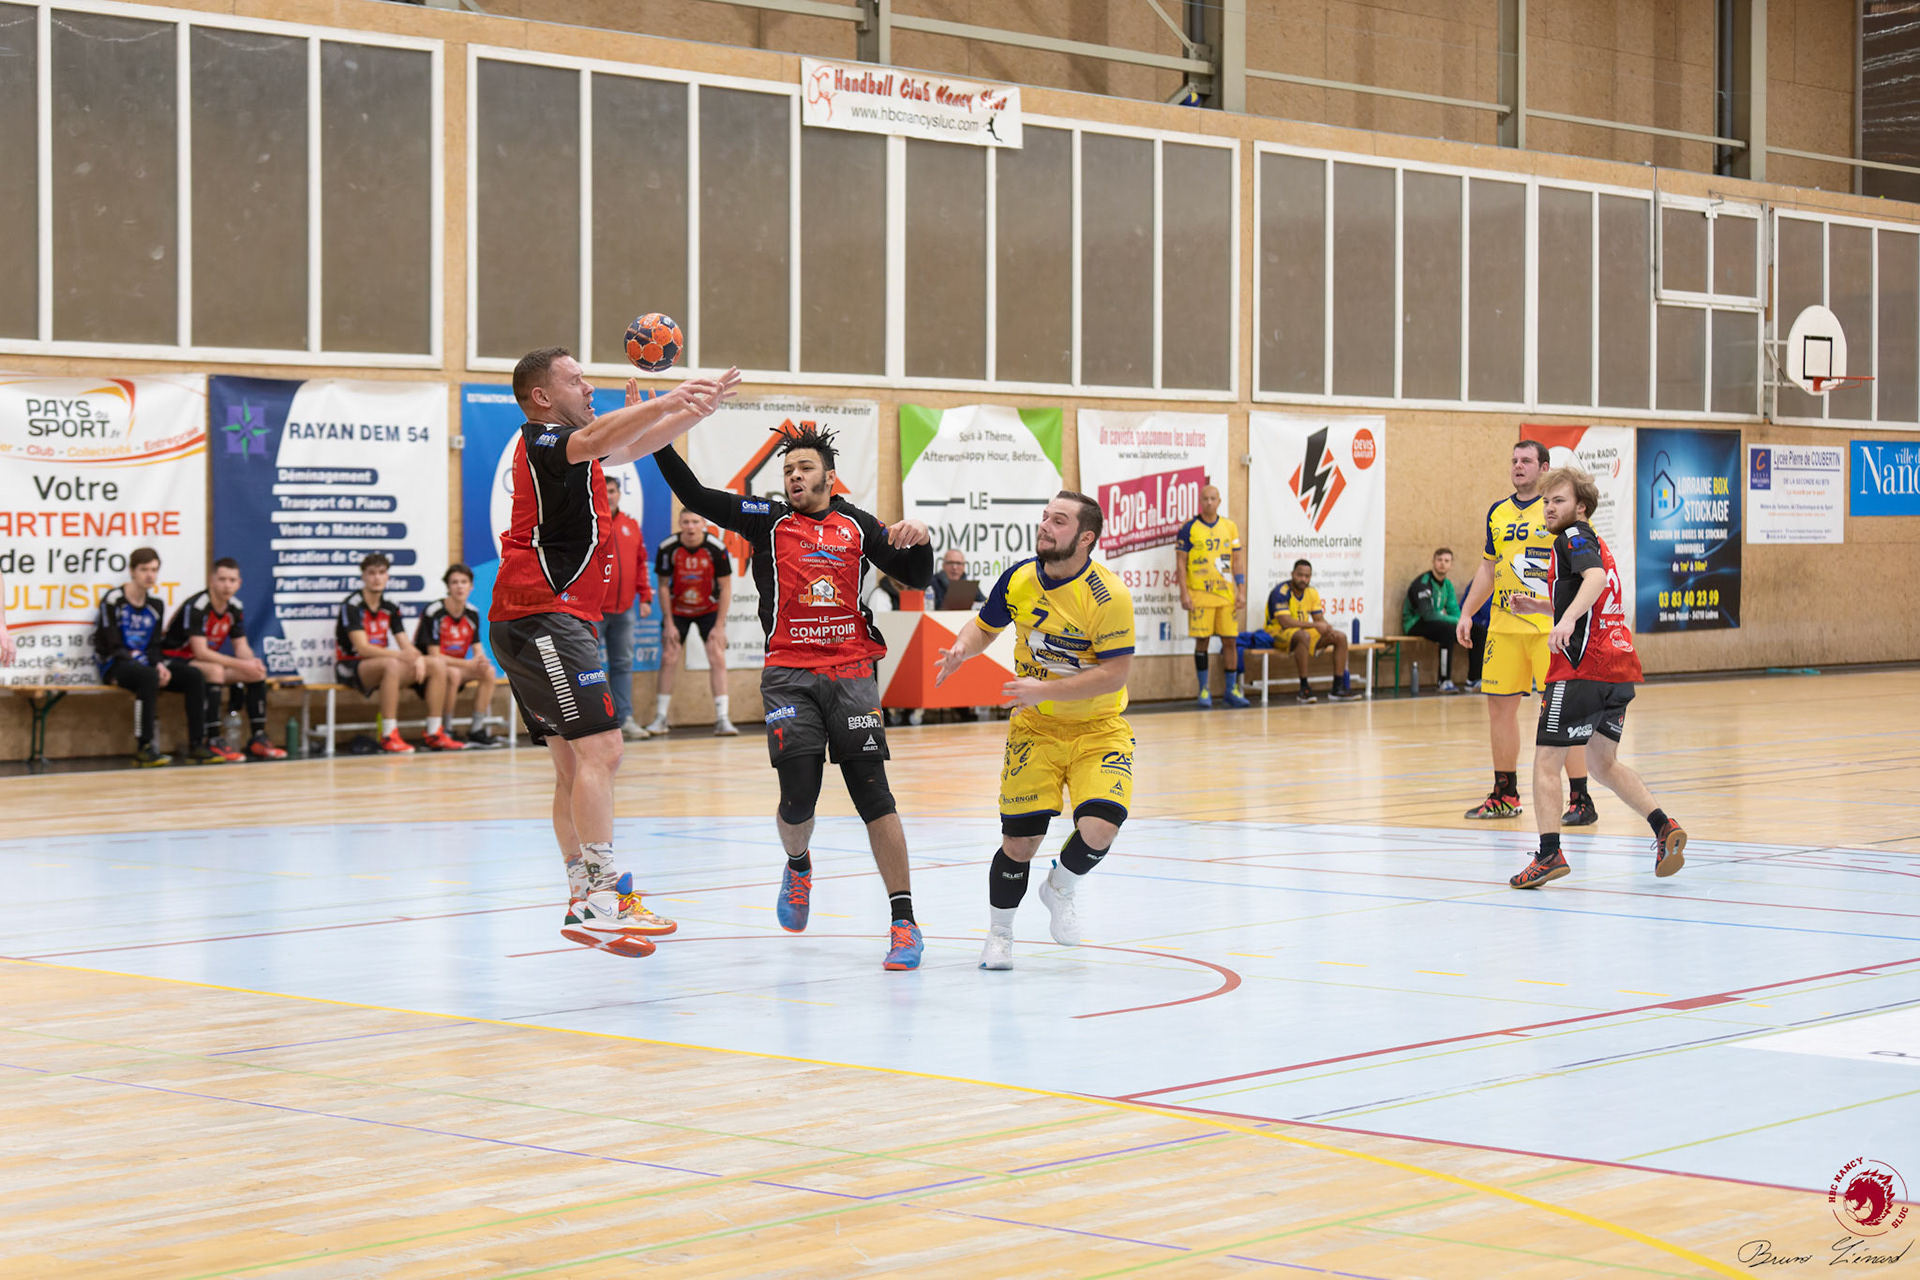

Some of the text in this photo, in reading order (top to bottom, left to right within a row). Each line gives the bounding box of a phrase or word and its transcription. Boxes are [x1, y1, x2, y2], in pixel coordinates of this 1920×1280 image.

[834, 69, 894, 97] Handball
[900, 78, 931, 102] Club
[935, 85, 975, 114] Nancy
[851, 105, 980, 132] www.hbcnancysluc.com
[26, 399, 92, 418] PAYS
[716, 401, 871, 416] truisons ensemble votre avenir
[289, 423, 429, 442] RAYAN DEM 54
[1597, 448, 1618, 459] RADIO
[1894, 448, 1914, 464] ville
[33, 475, 118, 501] Votre
[1678, 477, 1729, 495] LORRAINE BOX
[279, 496, 391, 511] Transport de Piano
[969, 491, 988, 510] LE
[1109, 485, 1147, 536] Cave
[1156, 473, 1199, 526] Léon
[1684, 500, 1730, 522] STOCKAGE
[279, 524, 313, 536] Vente
[315, 524, 330, 536] de
[1503, 522, 1529, 542] 36
[800, 540, 847, 552] Guy Hoquet
[1206, 538, 1220, 551] 97
[1273, 534, 1362, 547] HelloHomeLorraine
[0, 549, 129, 573] de l'effo
[278, 551, 329, 563] Location
[331, 551, 346, 563] de
[276, 578, 408, 591] Particulier Enrise
[1123, 570, 1141, 588] 83
[1146, 570, 1160, 587] 17
[1168, 593, 1181, 602] Bro
[1659, 589, 1719, 608] 03 83 40 23 99
[276, 606, 329, 618] Location
[1133, 606, 1174, 615] 4000 NANCY
[1330, 597, 1364, 615] 34 46
[1031, 607, 1049, 628] 7
[790, 623, 855, 638] COMPTOIR
[16, 634, 83, 648] 03 83 18
[848, 715, 872, 724] PAYS
[1002, 872, 1024, 880] SELECT
